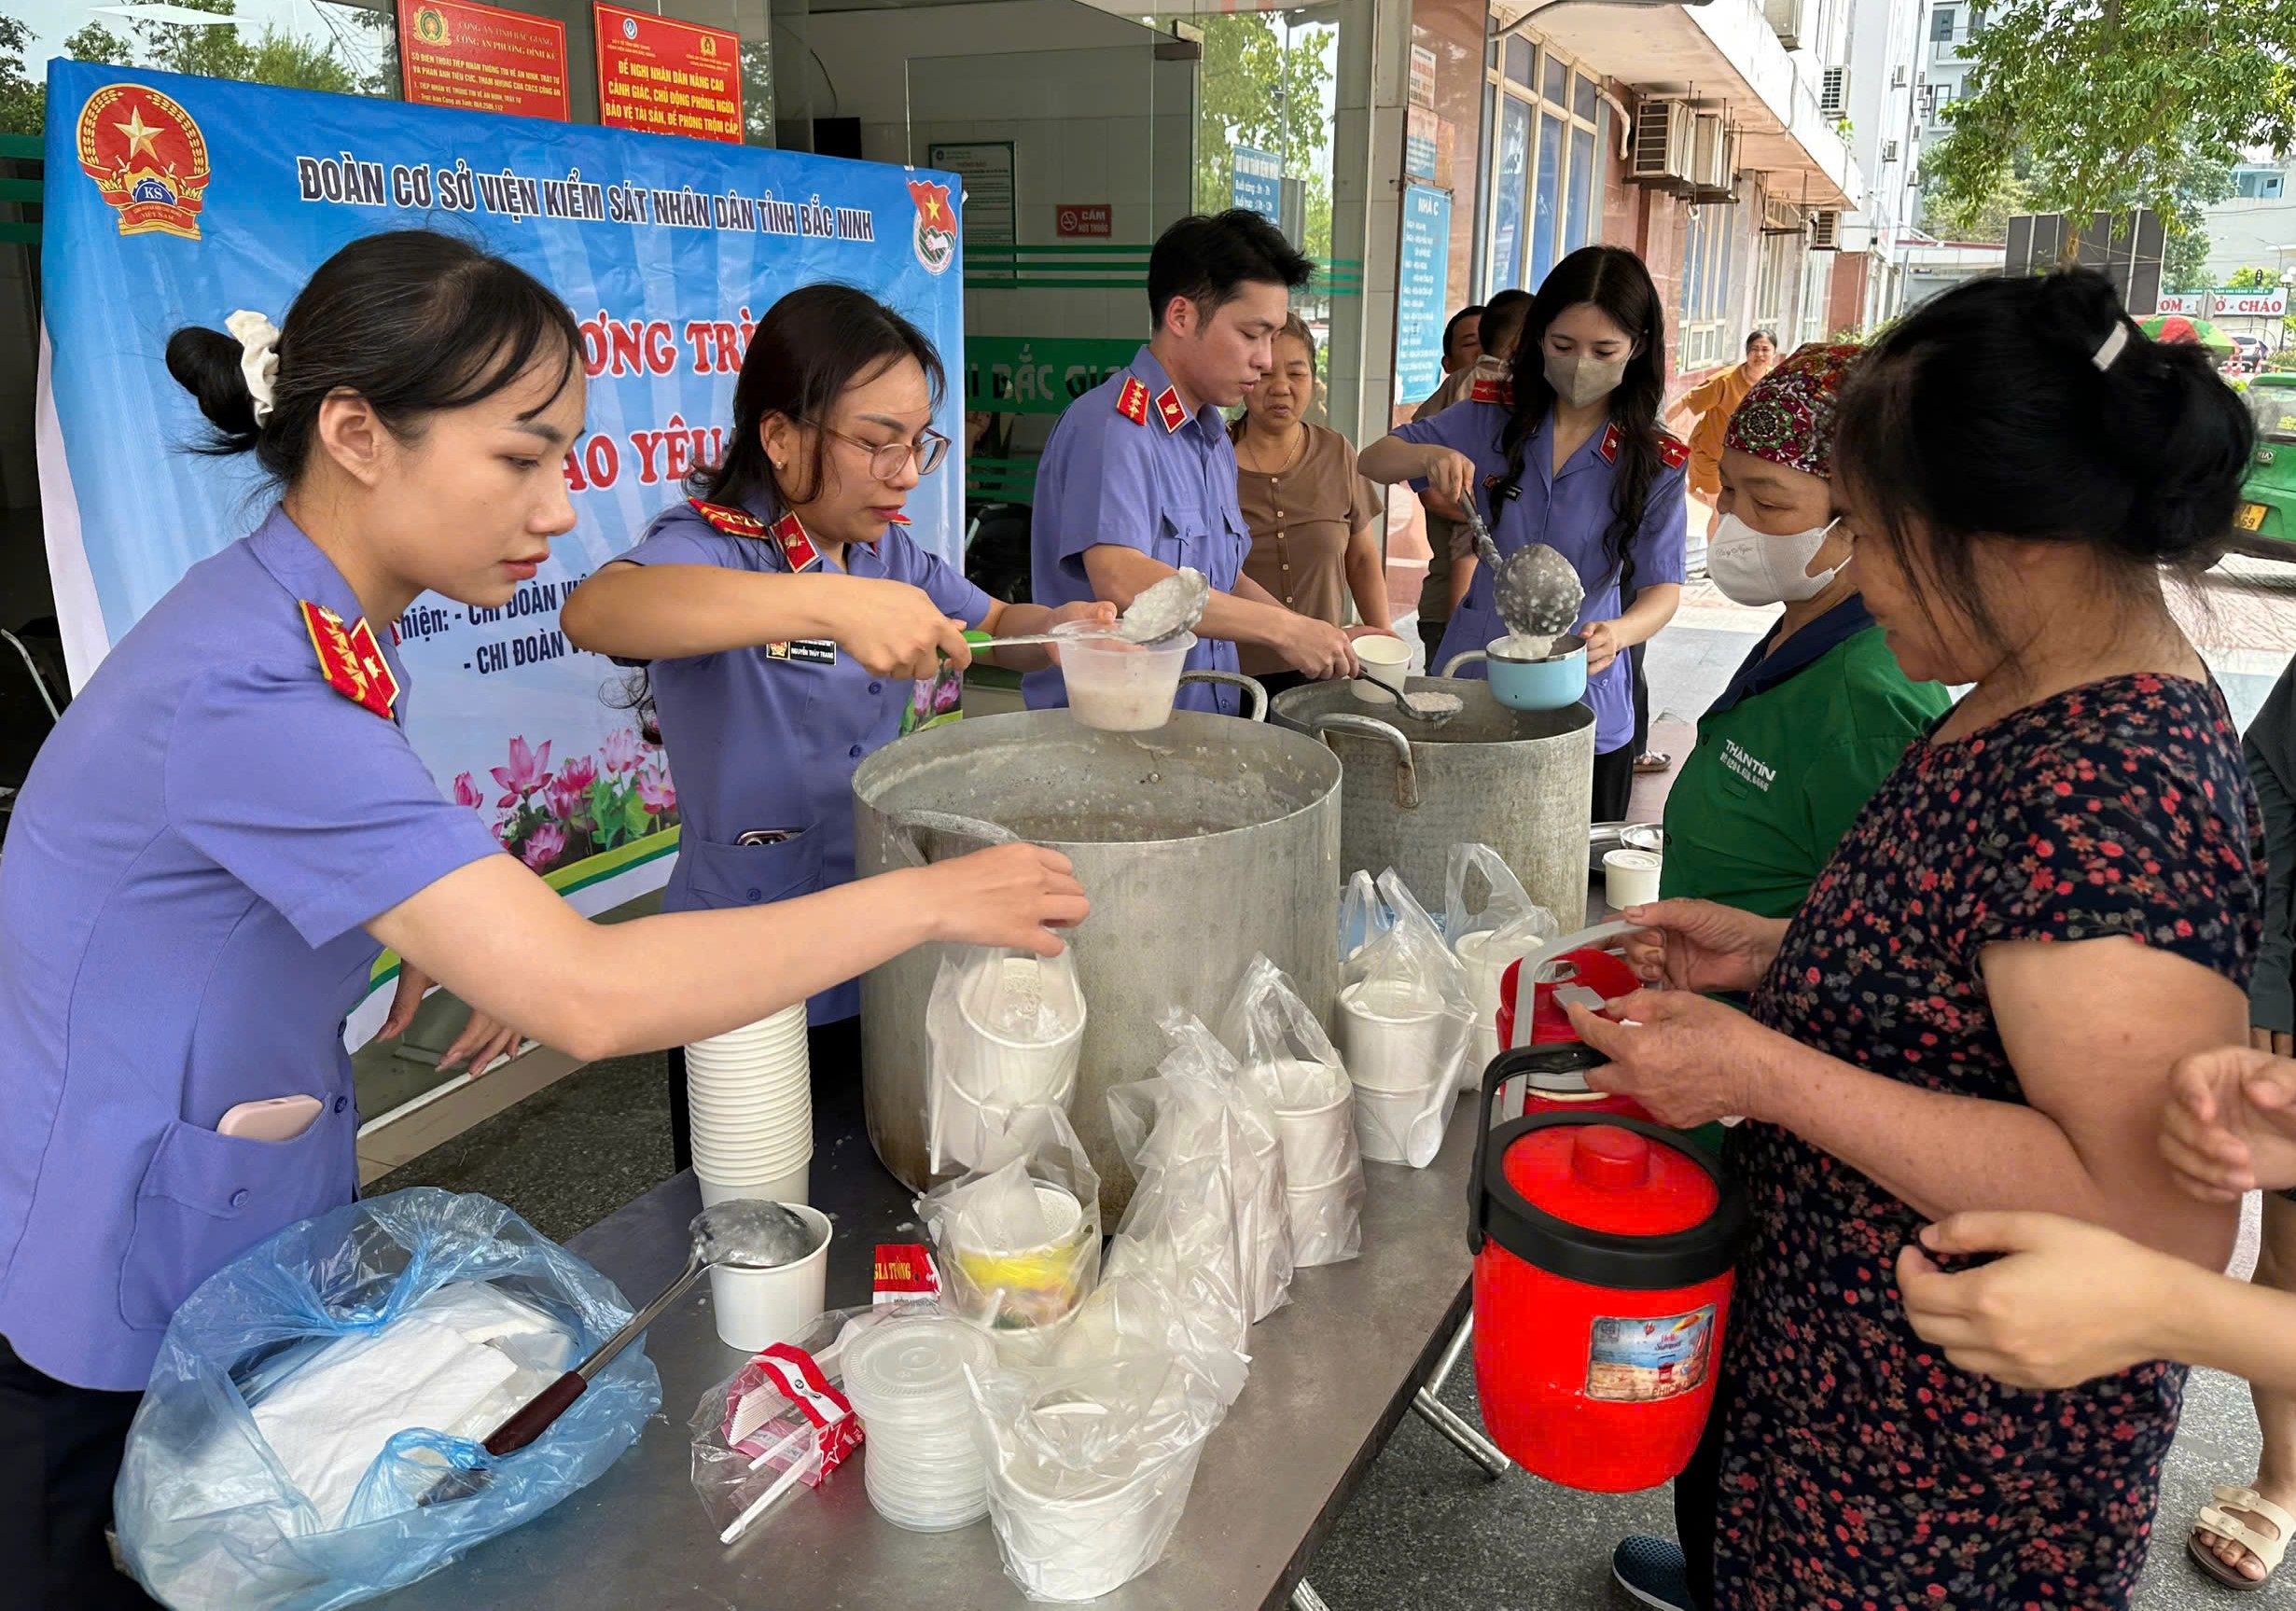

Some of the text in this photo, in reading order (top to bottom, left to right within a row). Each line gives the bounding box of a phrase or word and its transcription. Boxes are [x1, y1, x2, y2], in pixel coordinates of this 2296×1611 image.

[710, 78, 725, 92] CAO
[144, 186, 163, 200] KS
[297, 151, 386, 206] ĐOÀN
[392, 163, 433, 210] CƠ
[438, 158, 478, 212] SỞ
[478, 167, 541, 223] VIỆN
[542, 167, 605, 221] KIỂM
[607, 180, 647, 226] SÁT
[651, 185, 711, 229] NHÂN
[714, 190, 756, 232] DÂN
[758, 189, 798, 235] TỈNH
[800, 193, 834, 239] BẮC
[836, 208, 875, 243] NINH
[2159, 299, 2182, 312] ƠM
[2238, 298, 2282, 312] CHÁO
[578, 311, 678, 377] ƠNG
[992, 343, 1055, 404] BẮC
[629, 413, 723, 484] YÊU
[507, 581, 558, 619] ĐOÀN
[476, 641, 508, 674] CHI
[513, 628, 564, 667] ĐOÀN
